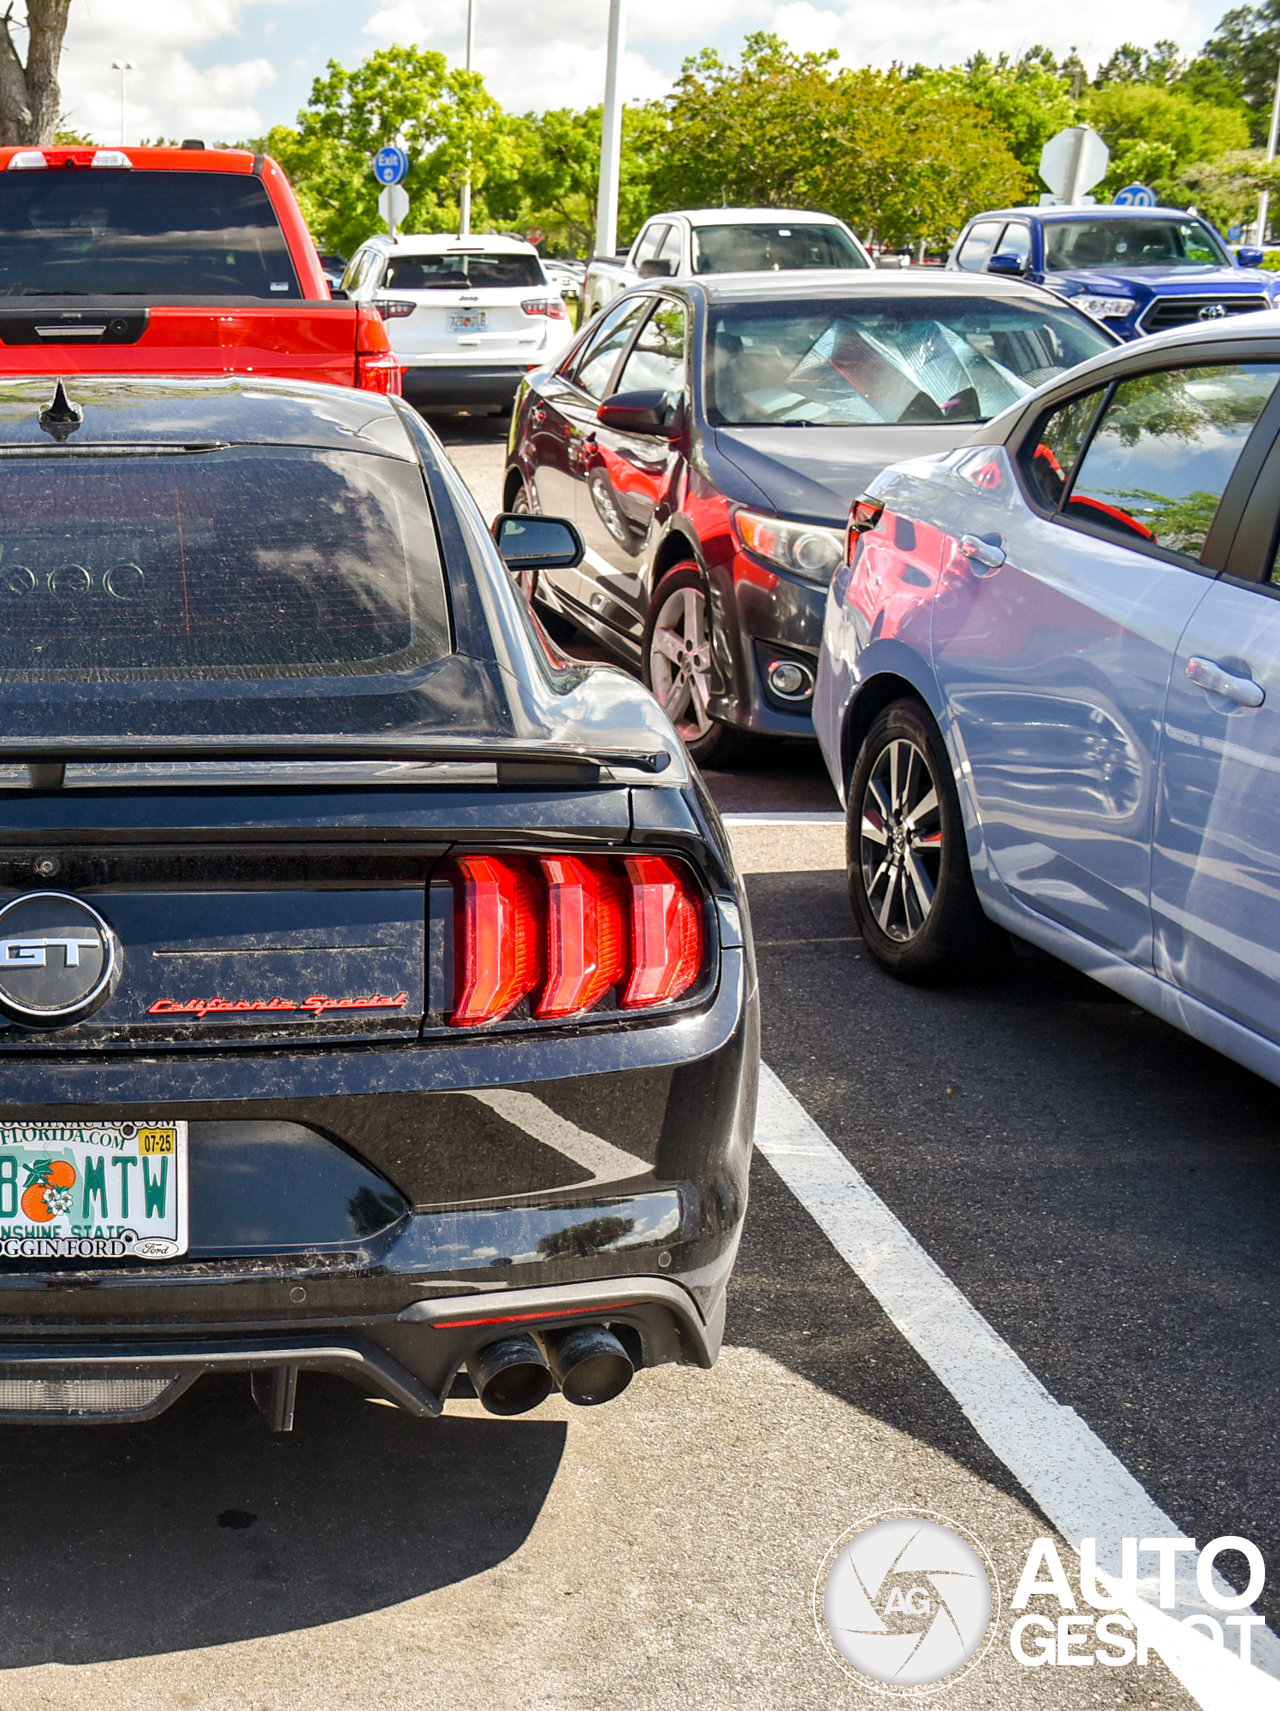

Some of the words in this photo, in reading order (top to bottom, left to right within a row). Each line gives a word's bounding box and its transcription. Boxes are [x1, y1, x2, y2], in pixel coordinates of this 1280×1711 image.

[378, 153, 399, 166] Exit
[148, 997, 297, 1018] California
[300, 991, 408, 1015] Special
[144, 1134, 171, 1152] 07-25
[82, 1156, 168, 1219] MTW
[66, 1239, 127, 1256] FORD
[144, 1241, 171, 1255] Ford
